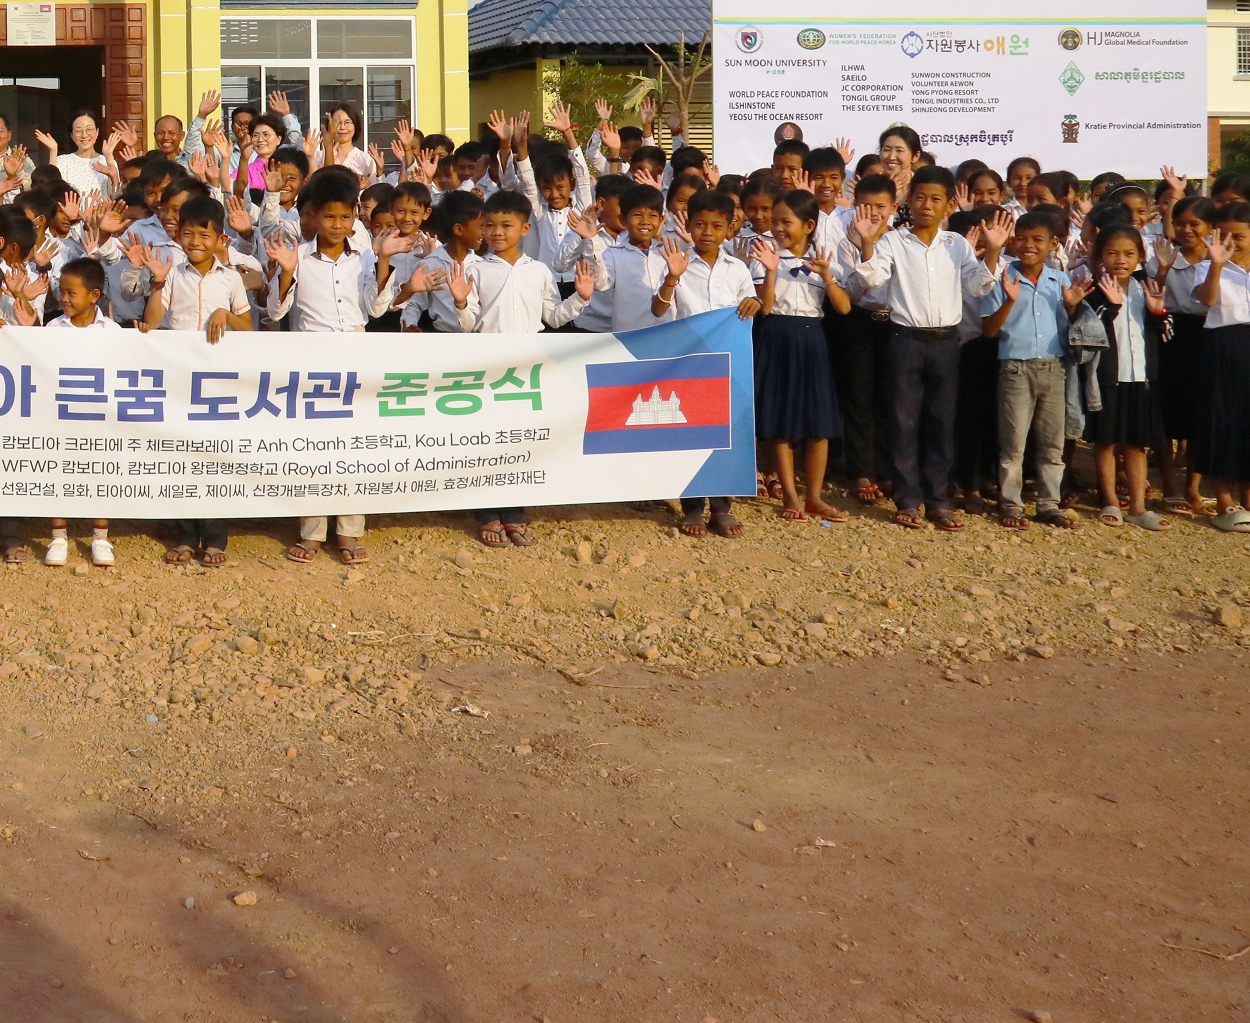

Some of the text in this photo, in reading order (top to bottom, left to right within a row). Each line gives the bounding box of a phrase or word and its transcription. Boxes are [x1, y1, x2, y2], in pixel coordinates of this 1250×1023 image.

[925, 34, 1030, 56] 자원봉사 애원
[1087, 32, 1103, 46] HJ
[724, 59, 828, 67] SUN MOON UNIVERSITY
[728, 90, 828, 98] WORLD PEACE FOUNDATION
[54, 366, 167, 423] 큰꿈
[187, 370, 361, 421] 도서관
[375, 362, 543, 417] 준공식
[1, 435, 60, 451] 캄보디아
[64, 437, 123, 452] 크라티에
[126, 438, 142, 453] 주
[145, 439, 234, 454] 체트라보레이
[238, 439, 252, 454] 군
[256, 437, 288, 453] Anh
[292, 436, 346, 452] Chanh
[350, 434, 412, 450] 초등학교,
[415, 433, 446, 448] Kou
[450, 431, 491, 447] Loab
[494, 427, 551, 444] 초등학교
[1, 459, 58, 473] WFWP
[62, 461, 124, 477] 캄보디아,
[127, 461, 186, 476] 캄보디아
[190, 461, 278, 476] 왕립행정학교
[282, 460, 332, 478] (Royal
[336, 459, 390, 476] School
[394, 458, 410, 474] of
[413, 450, 532, 473] Administration)
[1, 482, 58, 498] 선원건설,
[62, 483, 92, 499] 일화,
[96, 484, 154, 500] 티아이씨,
[158, 484, 201, 499] 세일로,
[205, 483, 249, 499] 제이씨,
[252, 483, 351, 498] 신정개발특장차,
[353, 480, 408, 497] 자원봉사
[410, 478, 439, 494] 애원,
[442, 469, 546, 491] 효정세계평화재단
